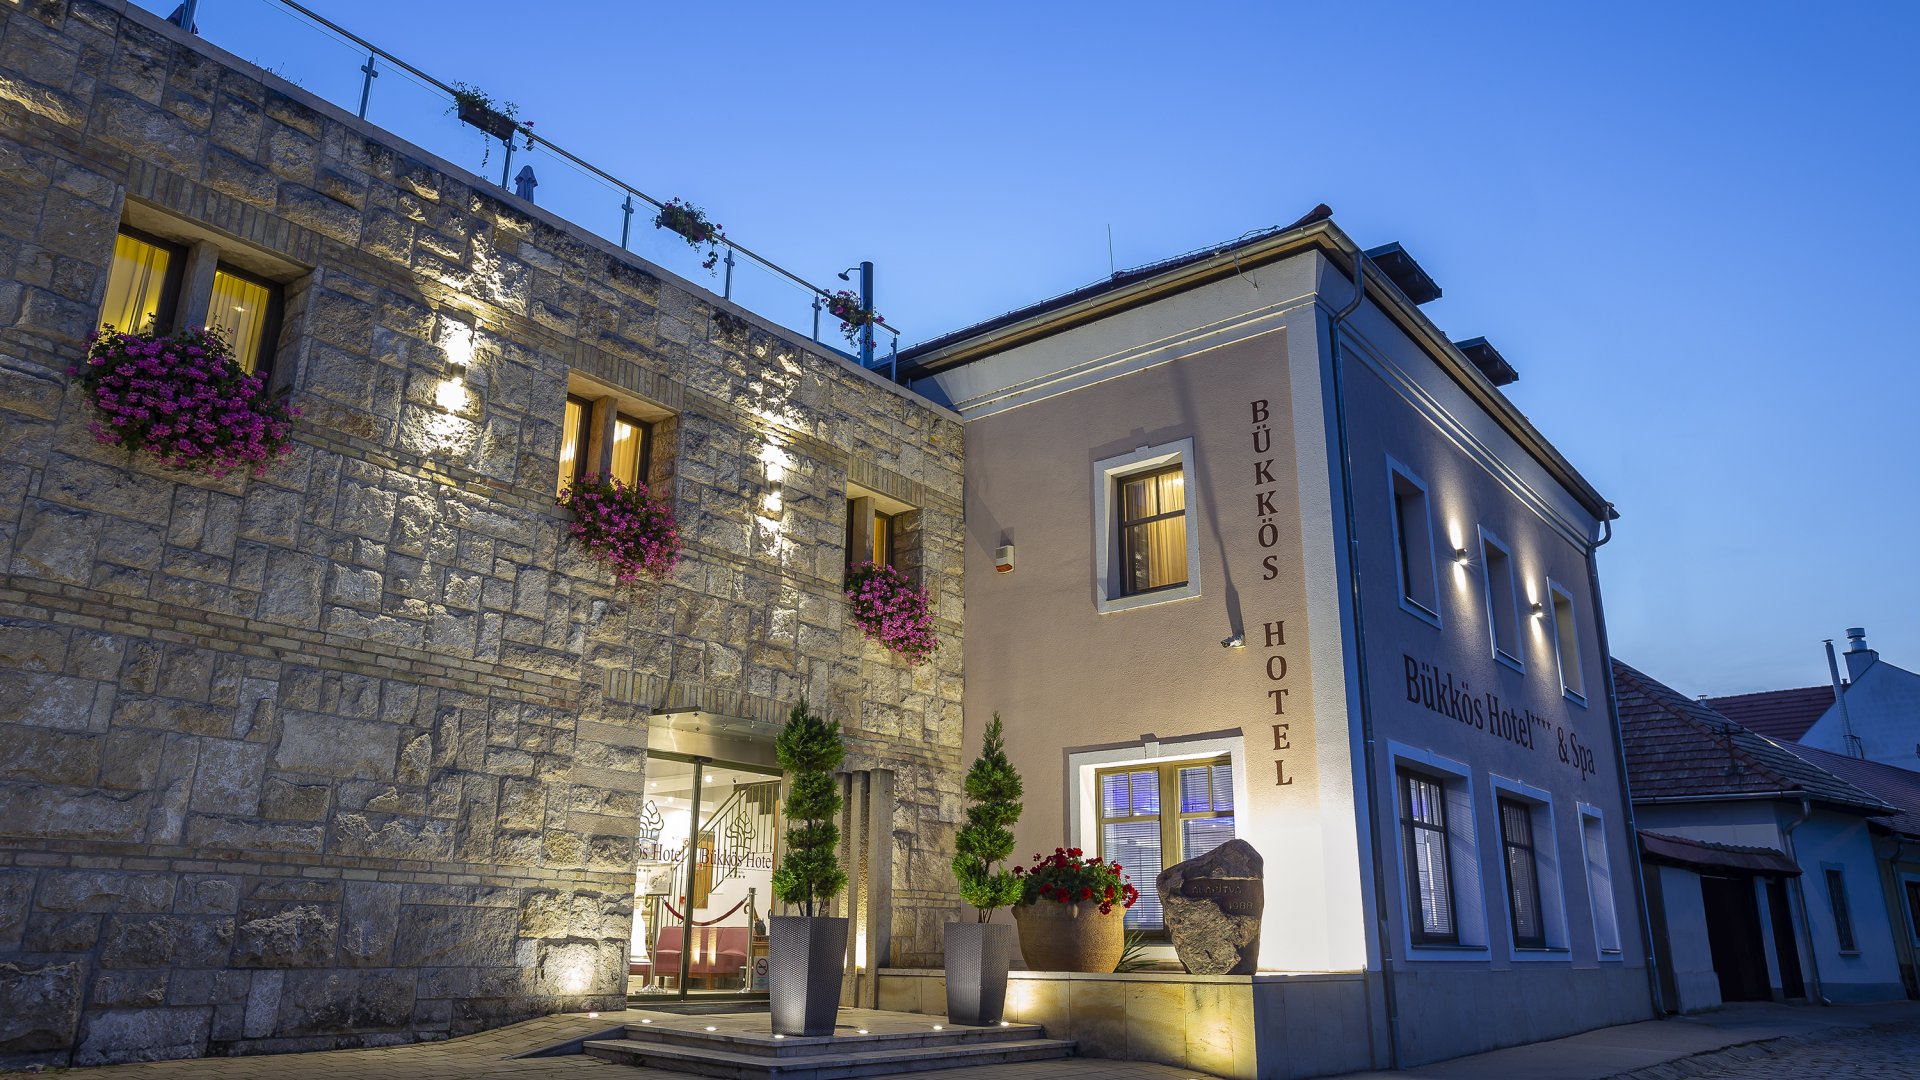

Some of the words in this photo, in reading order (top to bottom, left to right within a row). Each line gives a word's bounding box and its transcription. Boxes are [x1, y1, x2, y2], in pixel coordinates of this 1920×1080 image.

[1250, 399, 1280, 581] BÜKKÖS
[1263, 620, 1293, 786] HOTEL
[1403, 654, 1484, 730] Bükkös
[1557, 726, 1570, 765] &
[1570, 732, 1596, 781] Spa
[651, 843, 685, 862] Hotel
[701, 847, 743, 867] Bükkös
[1229, 901, 1254, 910] 1988
